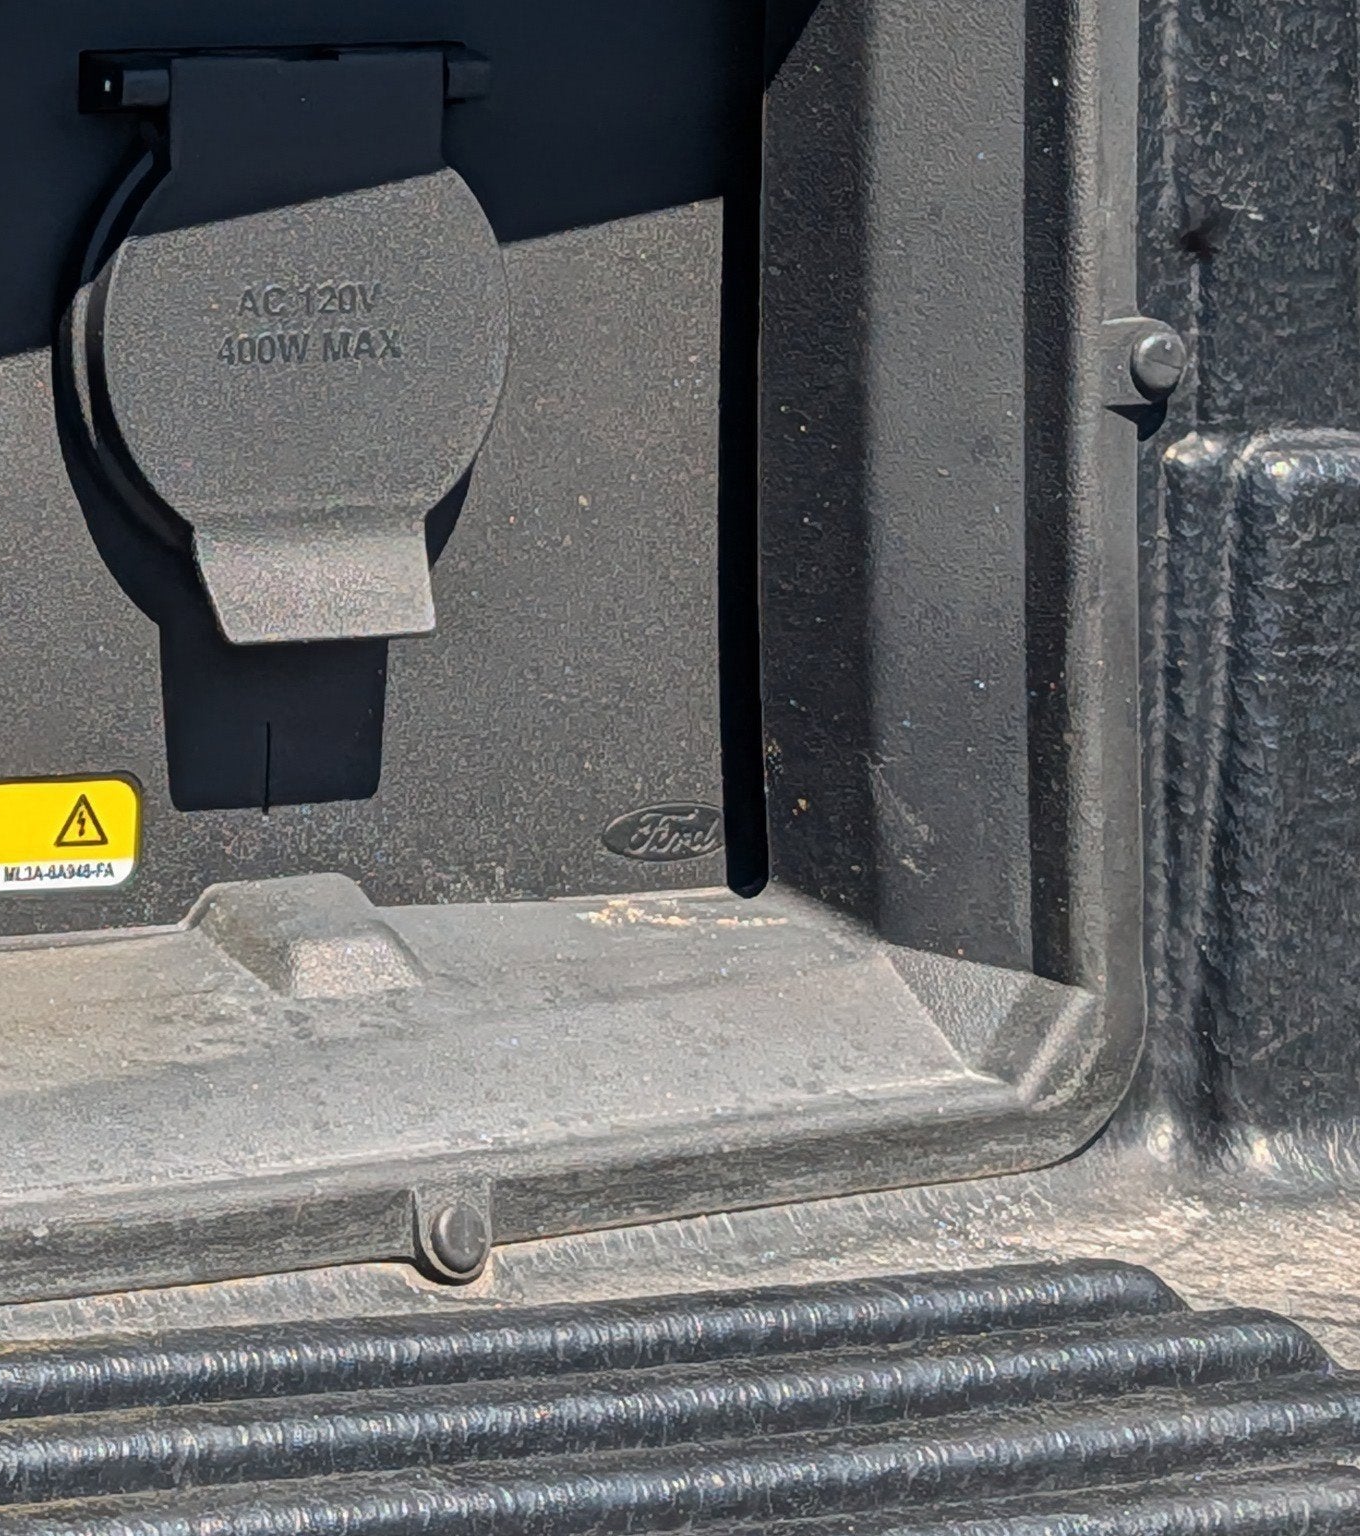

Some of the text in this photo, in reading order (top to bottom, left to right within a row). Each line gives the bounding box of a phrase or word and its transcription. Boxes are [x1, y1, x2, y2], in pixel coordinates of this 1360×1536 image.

[238, 282, 381, 316] AC 120V
[217, 327, 402, 364] 400W MAX
[626, 811, 723, 855] Ford
